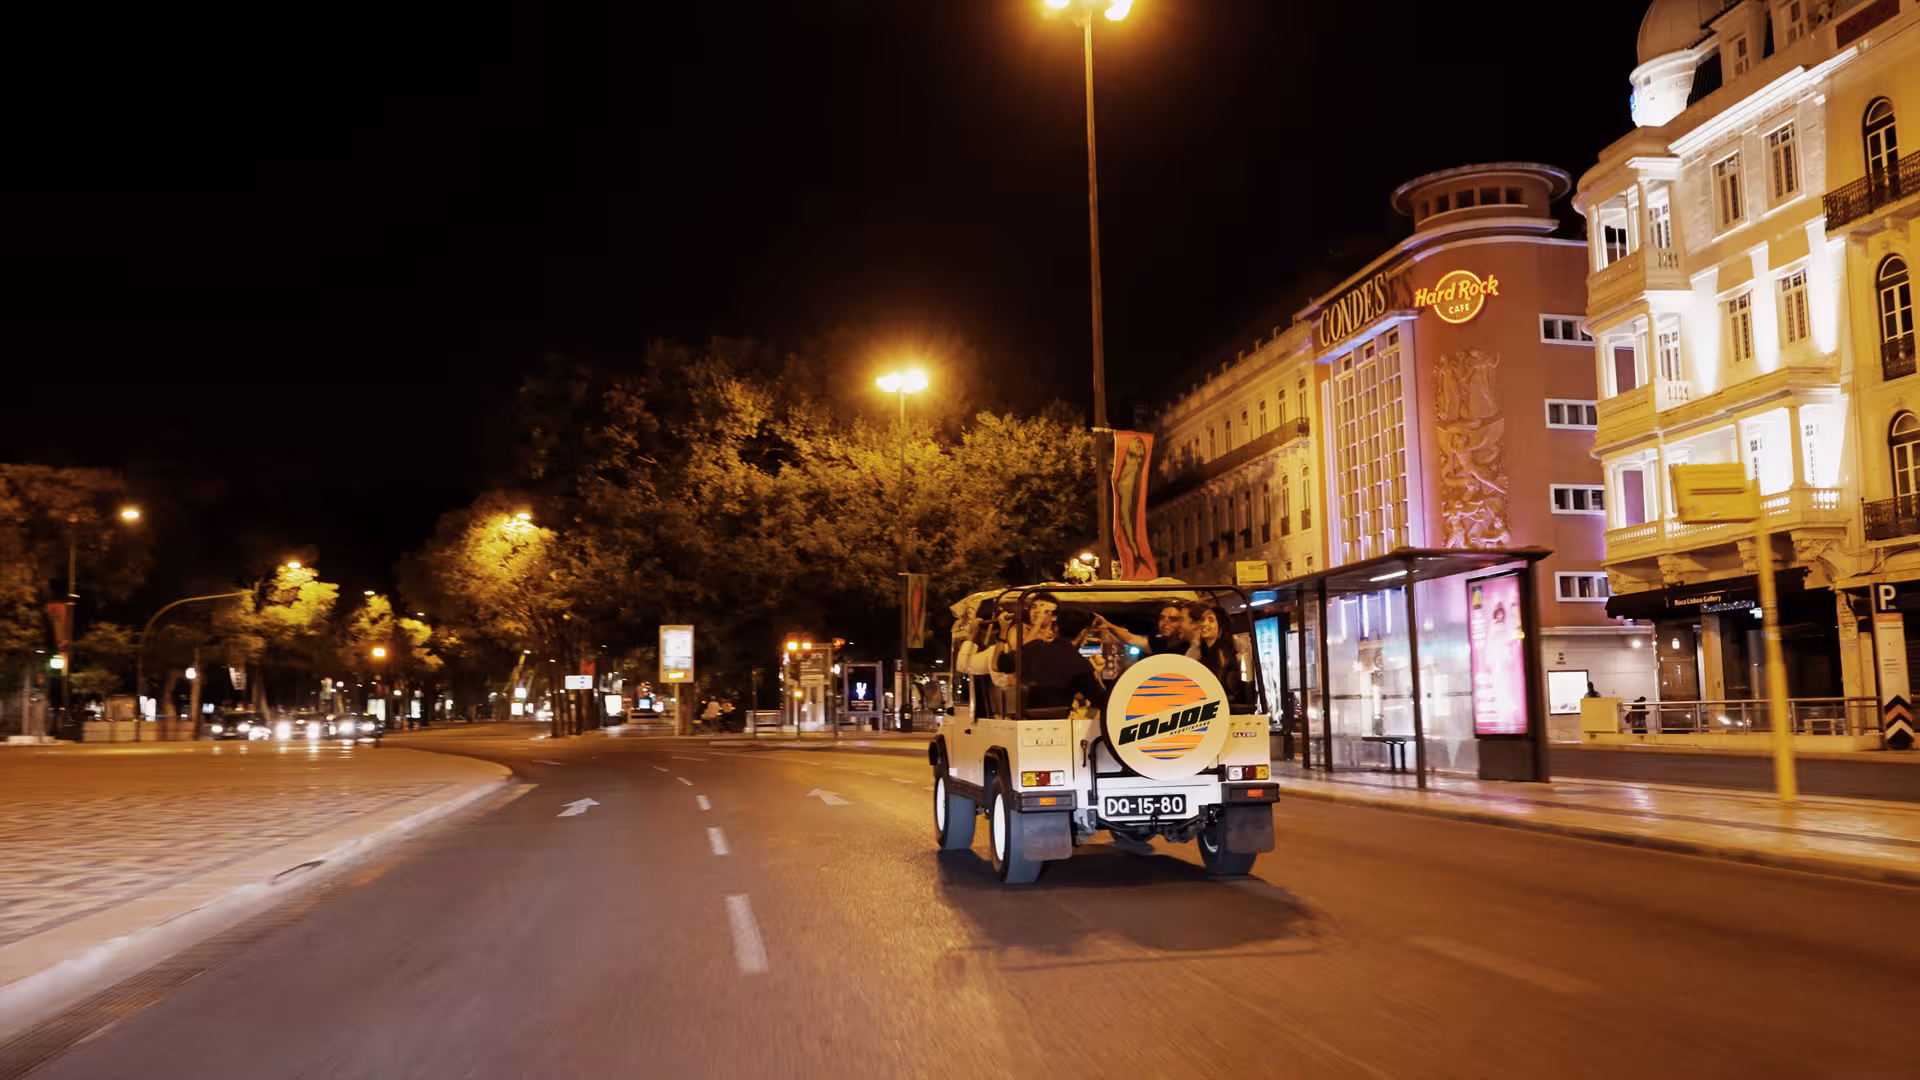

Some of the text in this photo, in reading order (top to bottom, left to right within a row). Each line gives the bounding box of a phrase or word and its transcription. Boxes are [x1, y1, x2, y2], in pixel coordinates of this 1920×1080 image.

[1414, 274, 1499, 308] Hard Rock
[1448, 303, 1470, 314] CAFE
[1703, 595, 1721, 603] Gallery
[1878, 584, 1896, 610] P
[1107, 796, 1183, 815] DQ-15-80
